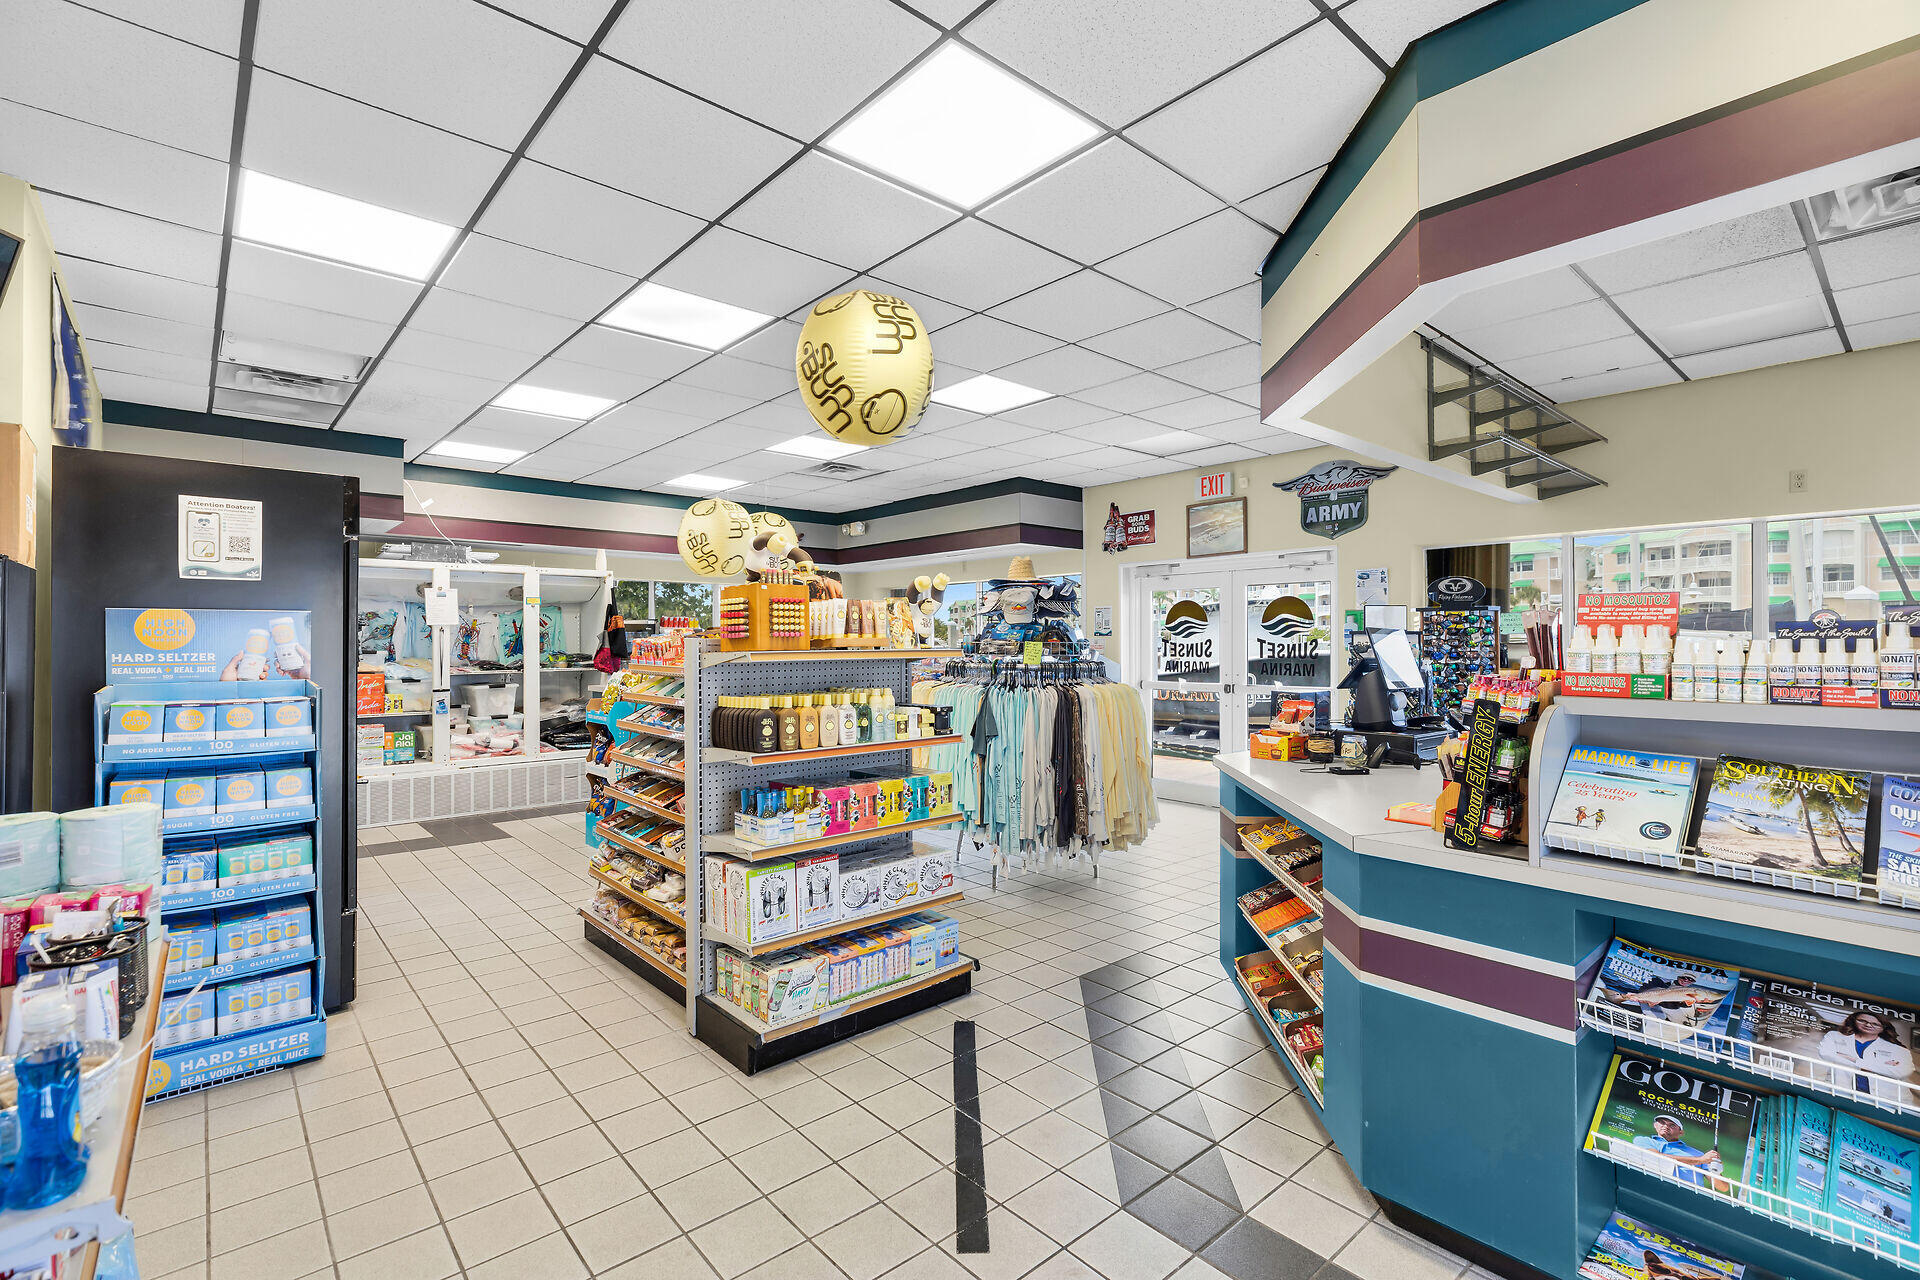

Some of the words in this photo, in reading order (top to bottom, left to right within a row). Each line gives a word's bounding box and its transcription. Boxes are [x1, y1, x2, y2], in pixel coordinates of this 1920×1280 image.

[1201, 473, 1225, 497] EXIT
[1298, 478, 1372, 497] Budweiser
[187, 500, 225, 508] Attention
[225, 503, 256, 511] Boaters!
[1306, 501, 1362, 523] ARMY
[1127, 513, 1150, 524] GRAB
[1127, 525, 1150, 534] BUDS
[1585, 595, 1601, 606] NO
[1603, 594, 1670, 606] MOSQUITOZ
[145, 618, 185, 628] HIGH
[1888, 612, 1909, 622] The
[142, 628, 188, 637] NOON
[1778, 628, 1793, 638] The
[1791, 628, 1816, 640] Secret
[1818, 628, 1827, 639] of
[1827, 628, 1841, 638] the
[1840, 627, 1874, 639] South!
[111, 653, 154, 663] HARD
[158, 652, 216, 662] SELTZER
[1891, 656, 1913, 664] NATZ
[134, 666, 162, 674] VODKA
[1565, 676, 1576, 686] NO
[1578, 676, 1626, 688] MOSQUITOZ
[1773, 687, 1790, 697] NO
[1790, 688, 1820, 698] NATZ
[1889, 690, 1908, 701] NO
[398, 733, 414, 741] Jai
[209, 740, 234, 750] 100
[249, 740, 275, 748] GLUTEN
[395, 740, 414, 748] Alai
[1465, 705, 1496, 791] ENERGY
[1573, 749, 1637, 768] MARINA
[1652, 759, 1691, 774] LIFE
[1724, 760, 1859, 795] SOUTHERN
[1744, 773, 1829, 792] BOATING
[1567, 780, 1638, 798] Celebrating
[1574, 789, 1588, 797] 25
[1592, 790, 1625, 802] Years
[1719, 787, 1784, 805] BAHAMAS
[166, 822, 193, 830] SUGAR
[209, 814, 234, 824] 100
[250, 812, 276, 821] GLUTEN
[278, 810, 300, 818] FREE
[1455, 786, 1484, 846] 5-hour
[1902, 820, 1917, 828] OF
[1888, 851, 1902, 860] THE
[815, 864, 830, 873] CLAW
[928, 858, 944, 868] CLAW
[769, 873, 785, 882] CLAW
[892, 866, 908, 876] CLAW
[850, 874, 867, 884] CLAW
[168, 897, 194, 906] SUGAR
[210, 888, 235, 899] 100
[250, 884, 281, 893] GLUTEN
[282, 881, 300, 889] FREE
[1620, 942, 1729, 978] FLORIDA
[167, 975, 193, 985] SUGAR
[209, 964, 234, 976] 100
[250, 956, 280, 968] GLUTEN
[282, 952, 300, 962] FREE
[1768, 1000, 1809, 1013] Labor
[1770, 982, 1846, 1007] Florida
[1847, 999, 1916, 1023] Trend
[1780, 1008, 1817, 1021] Pains
[180, 1050, 234, 1073] HARD
[238, 1031, 310, 1058] SELTZER
[180, 1075, 208, 1088] REAL
[209, 1066, 244, 1080] VODKA
[258, 1056, 283, 1068] REAL
[284, 1048, 310, 1061] JUICE
[1619, 1059, 1752, 1112] GOLF
[1638, 1089, 1675, 1107] ROCK
[1678, 1103, 1721, 1120] SOLID
[1842, 1127, 1889, 1152] CRIME
[1841, 1134, 1912, 1169] STOPPERS
[1616, 1217, 1735, 1274] OnBoard
